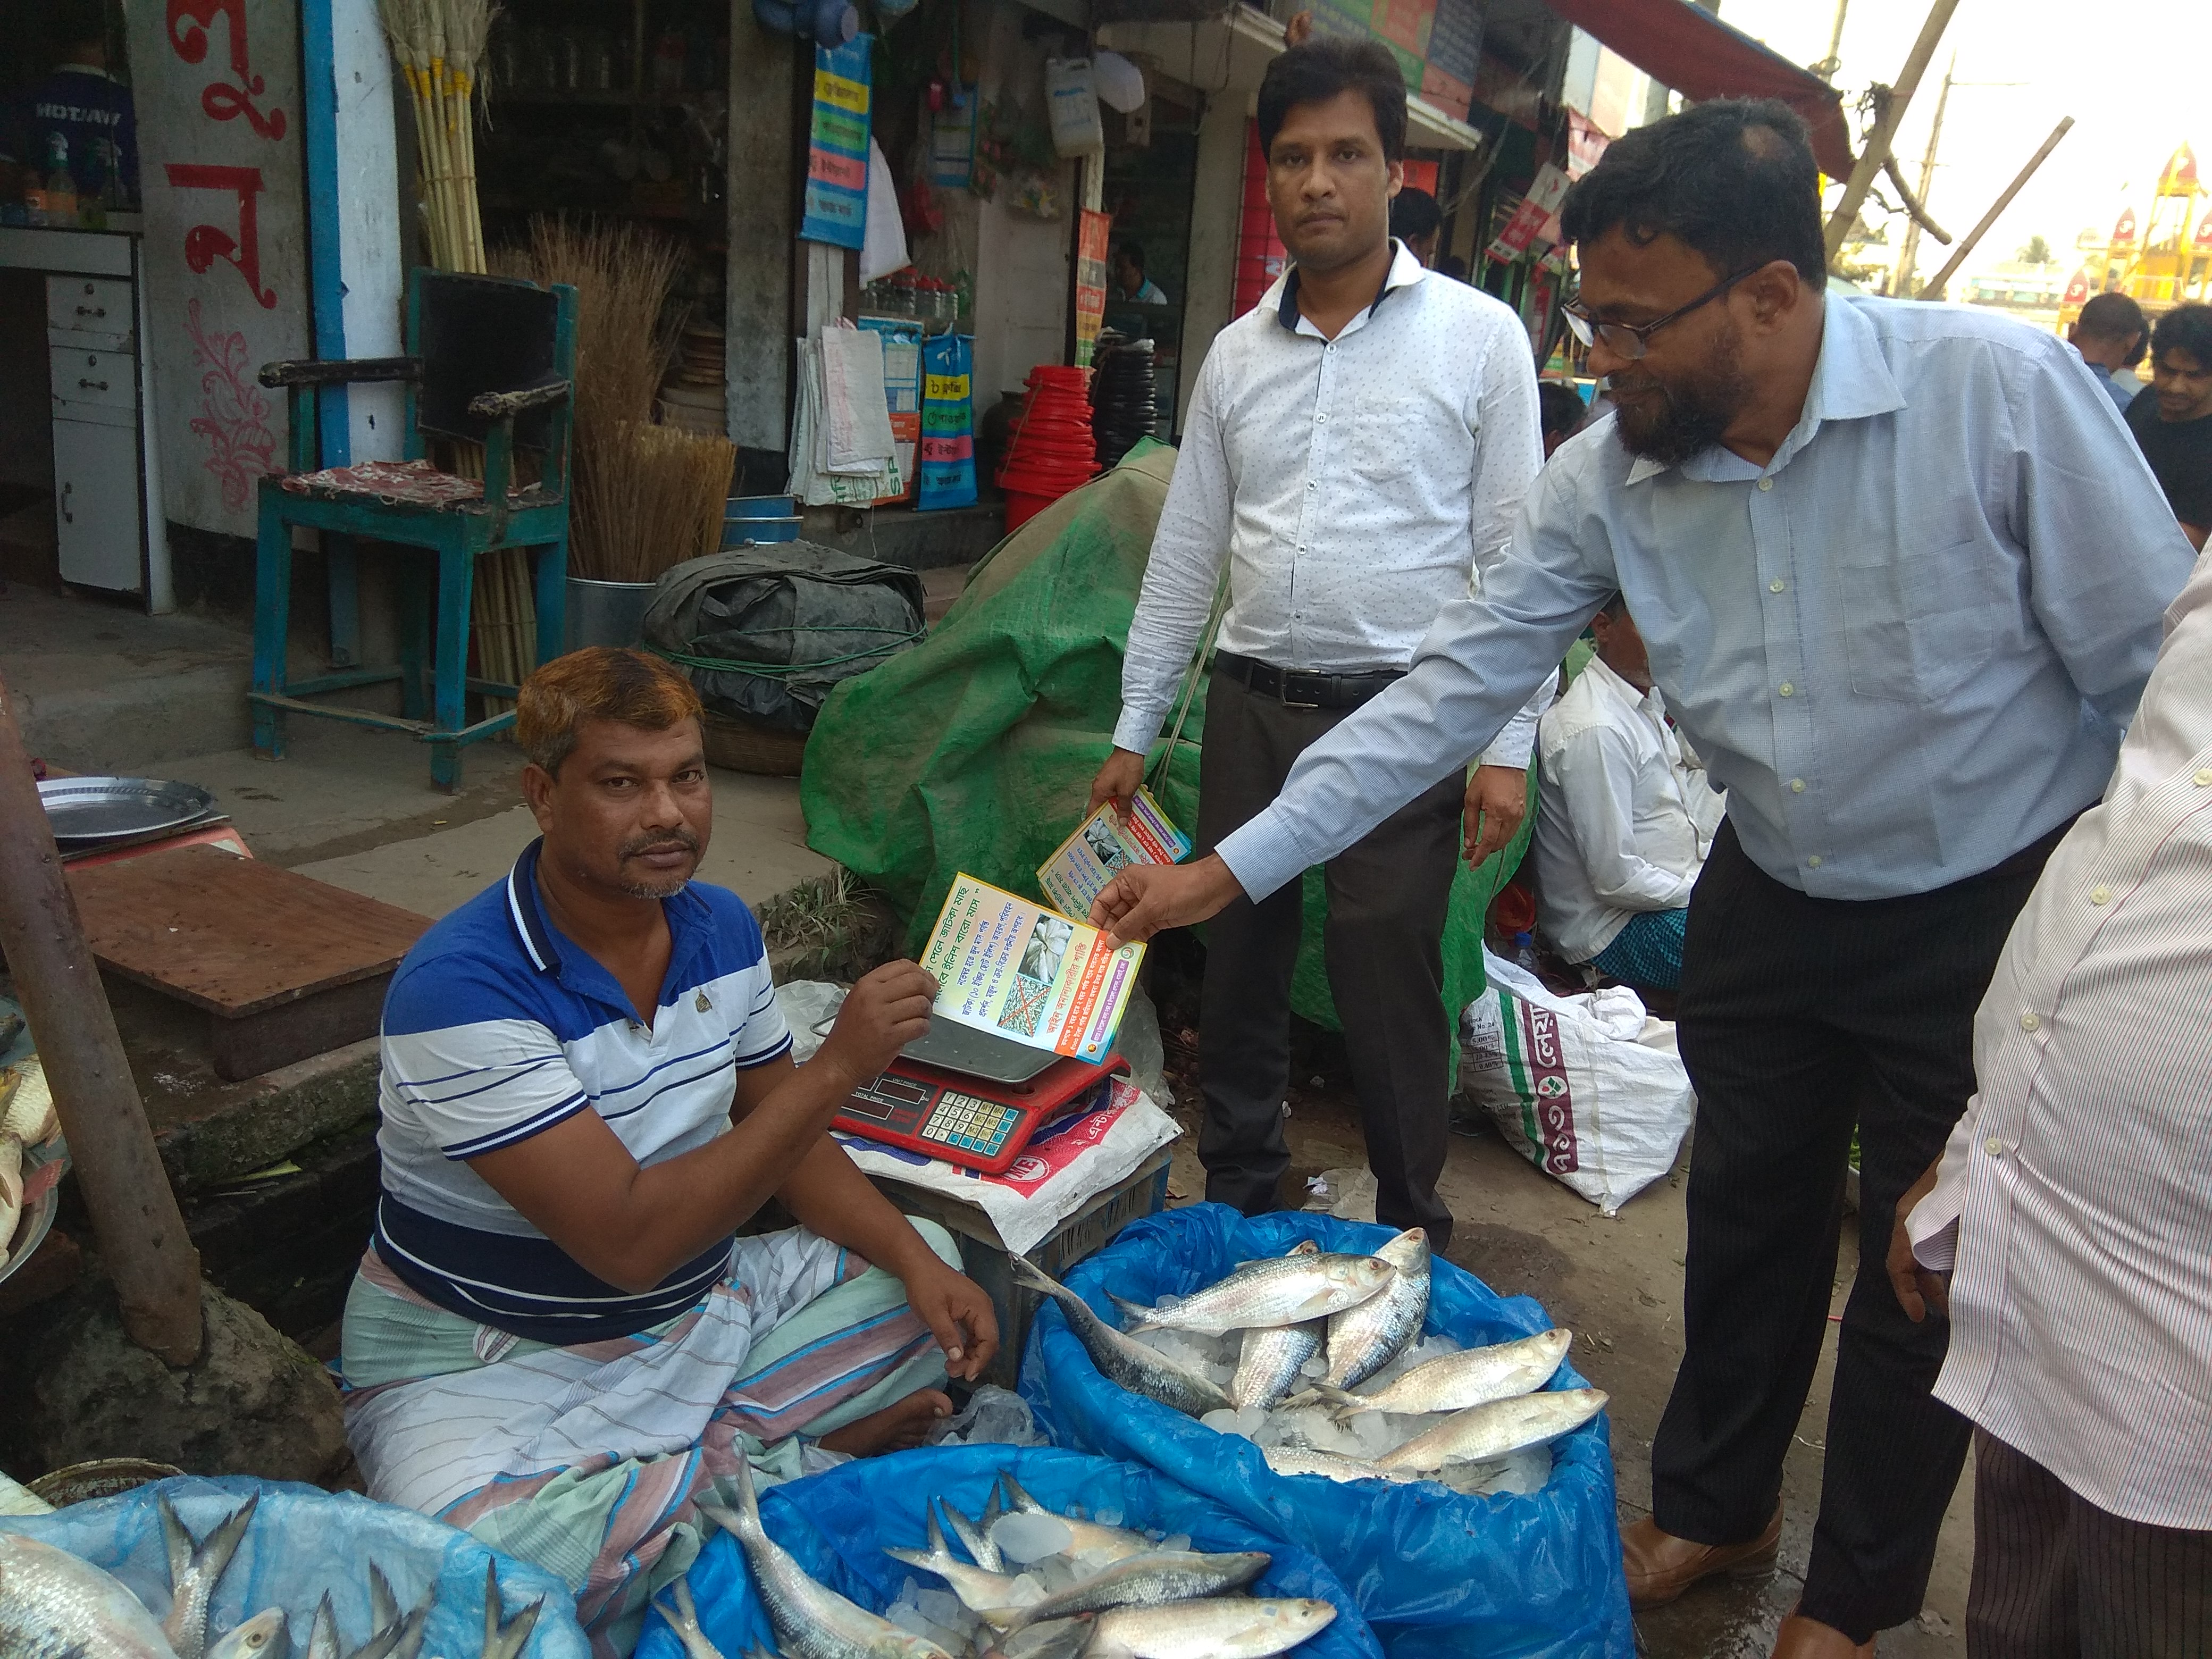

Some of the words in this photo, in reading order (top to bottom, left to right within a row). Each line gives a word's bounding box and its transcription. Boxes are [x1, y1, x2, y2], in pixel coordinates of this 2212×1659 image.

[929, 939, 944, 964] পেলে
[939, 906, 958, 937] জাটকা
[953, 885, 969, 906] মাছ
[941, 944, 960, 970] ইলিশ
[954, 918, 971, 943] বারো
[966, 898, 980, 917] মাস
[964, 954, 975, 967] হতে
[973, 933, 984, 944] মাস
[961, 998, 975, 1015] জাটকা
[979, 958, 990, 971] ছোট
[1046, 1010, 1063, 1034] আইন
[1008, 1159, 1039, 1179] ME
